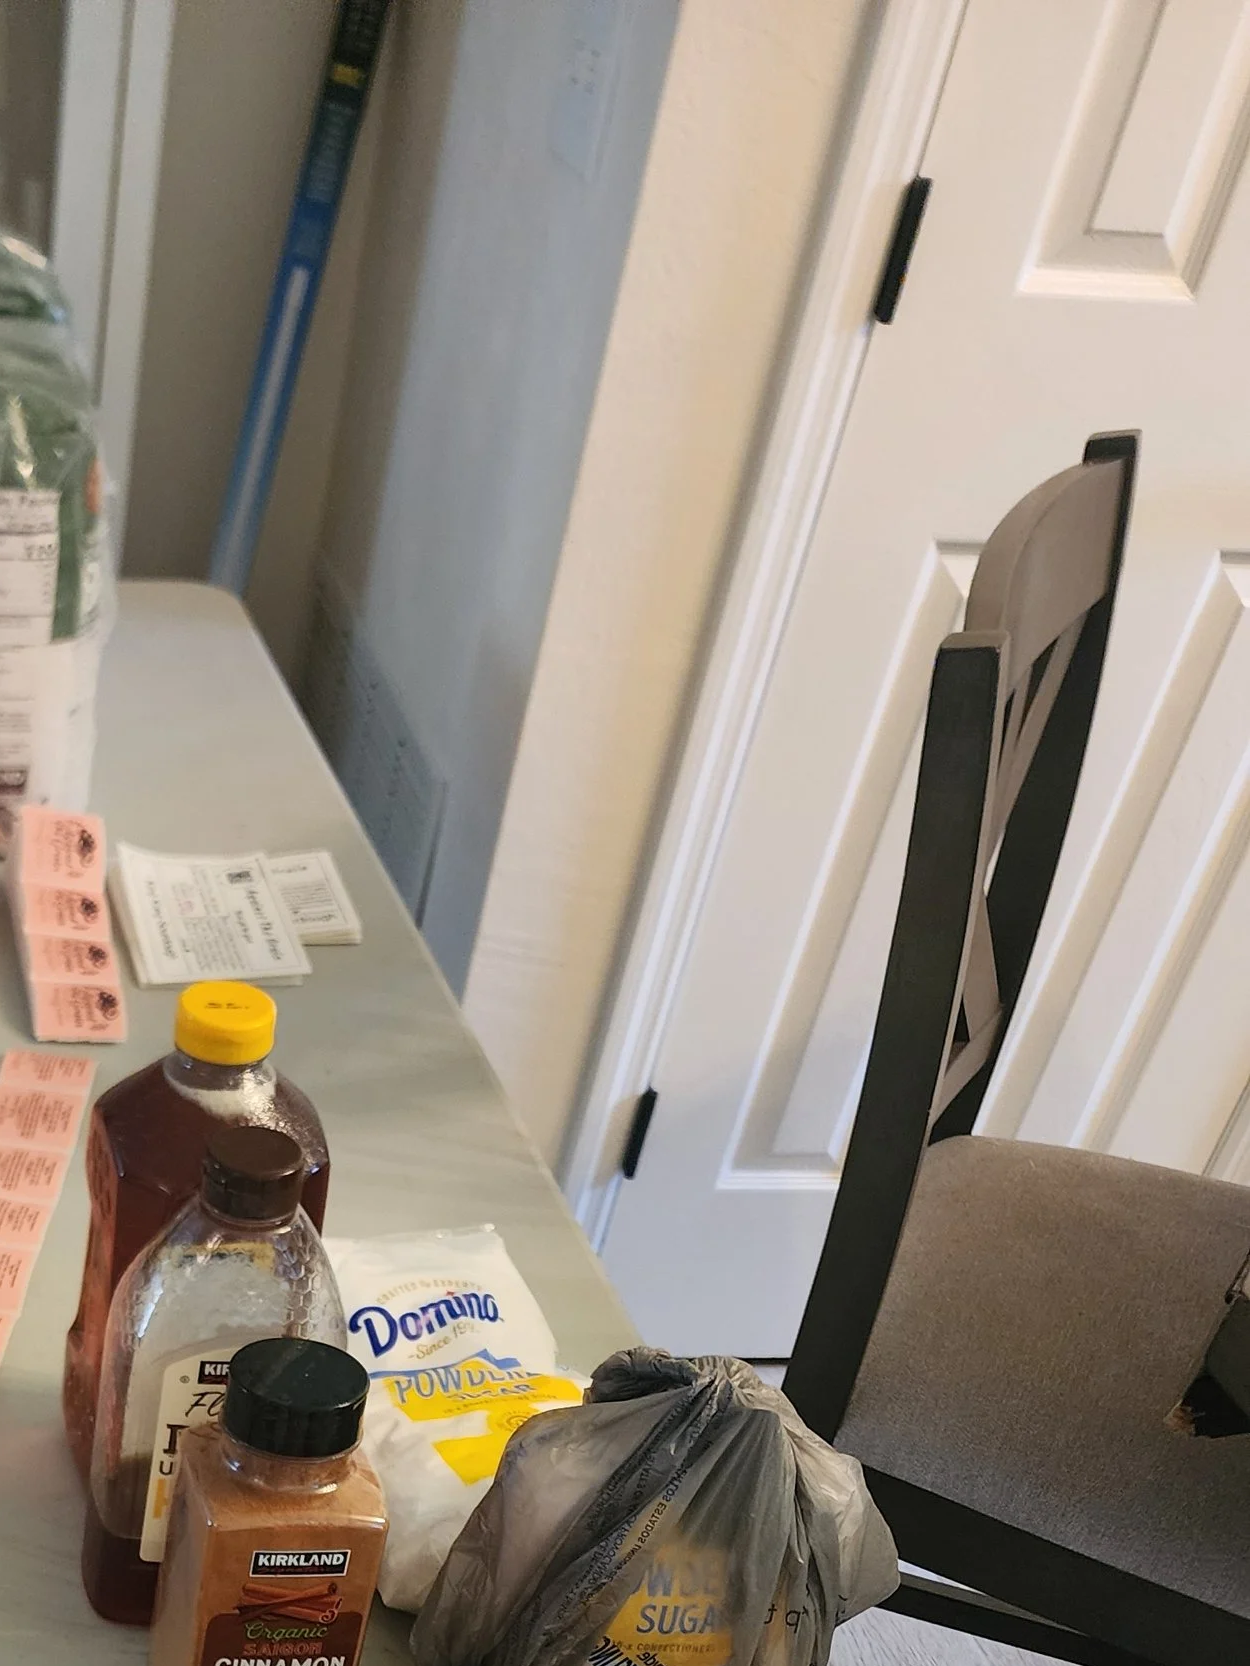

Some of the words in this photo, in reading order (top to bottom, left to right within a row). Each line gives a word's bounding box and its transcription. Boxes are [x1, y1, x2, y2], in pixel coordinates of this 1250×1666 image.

[349, 1292, 499, 1358] Domino
[257, 1553, 345, 1568] KIRKLAND
[245, 1621, 329, 1641] Organic
[636, 1604, 719, 1635] SUGA
